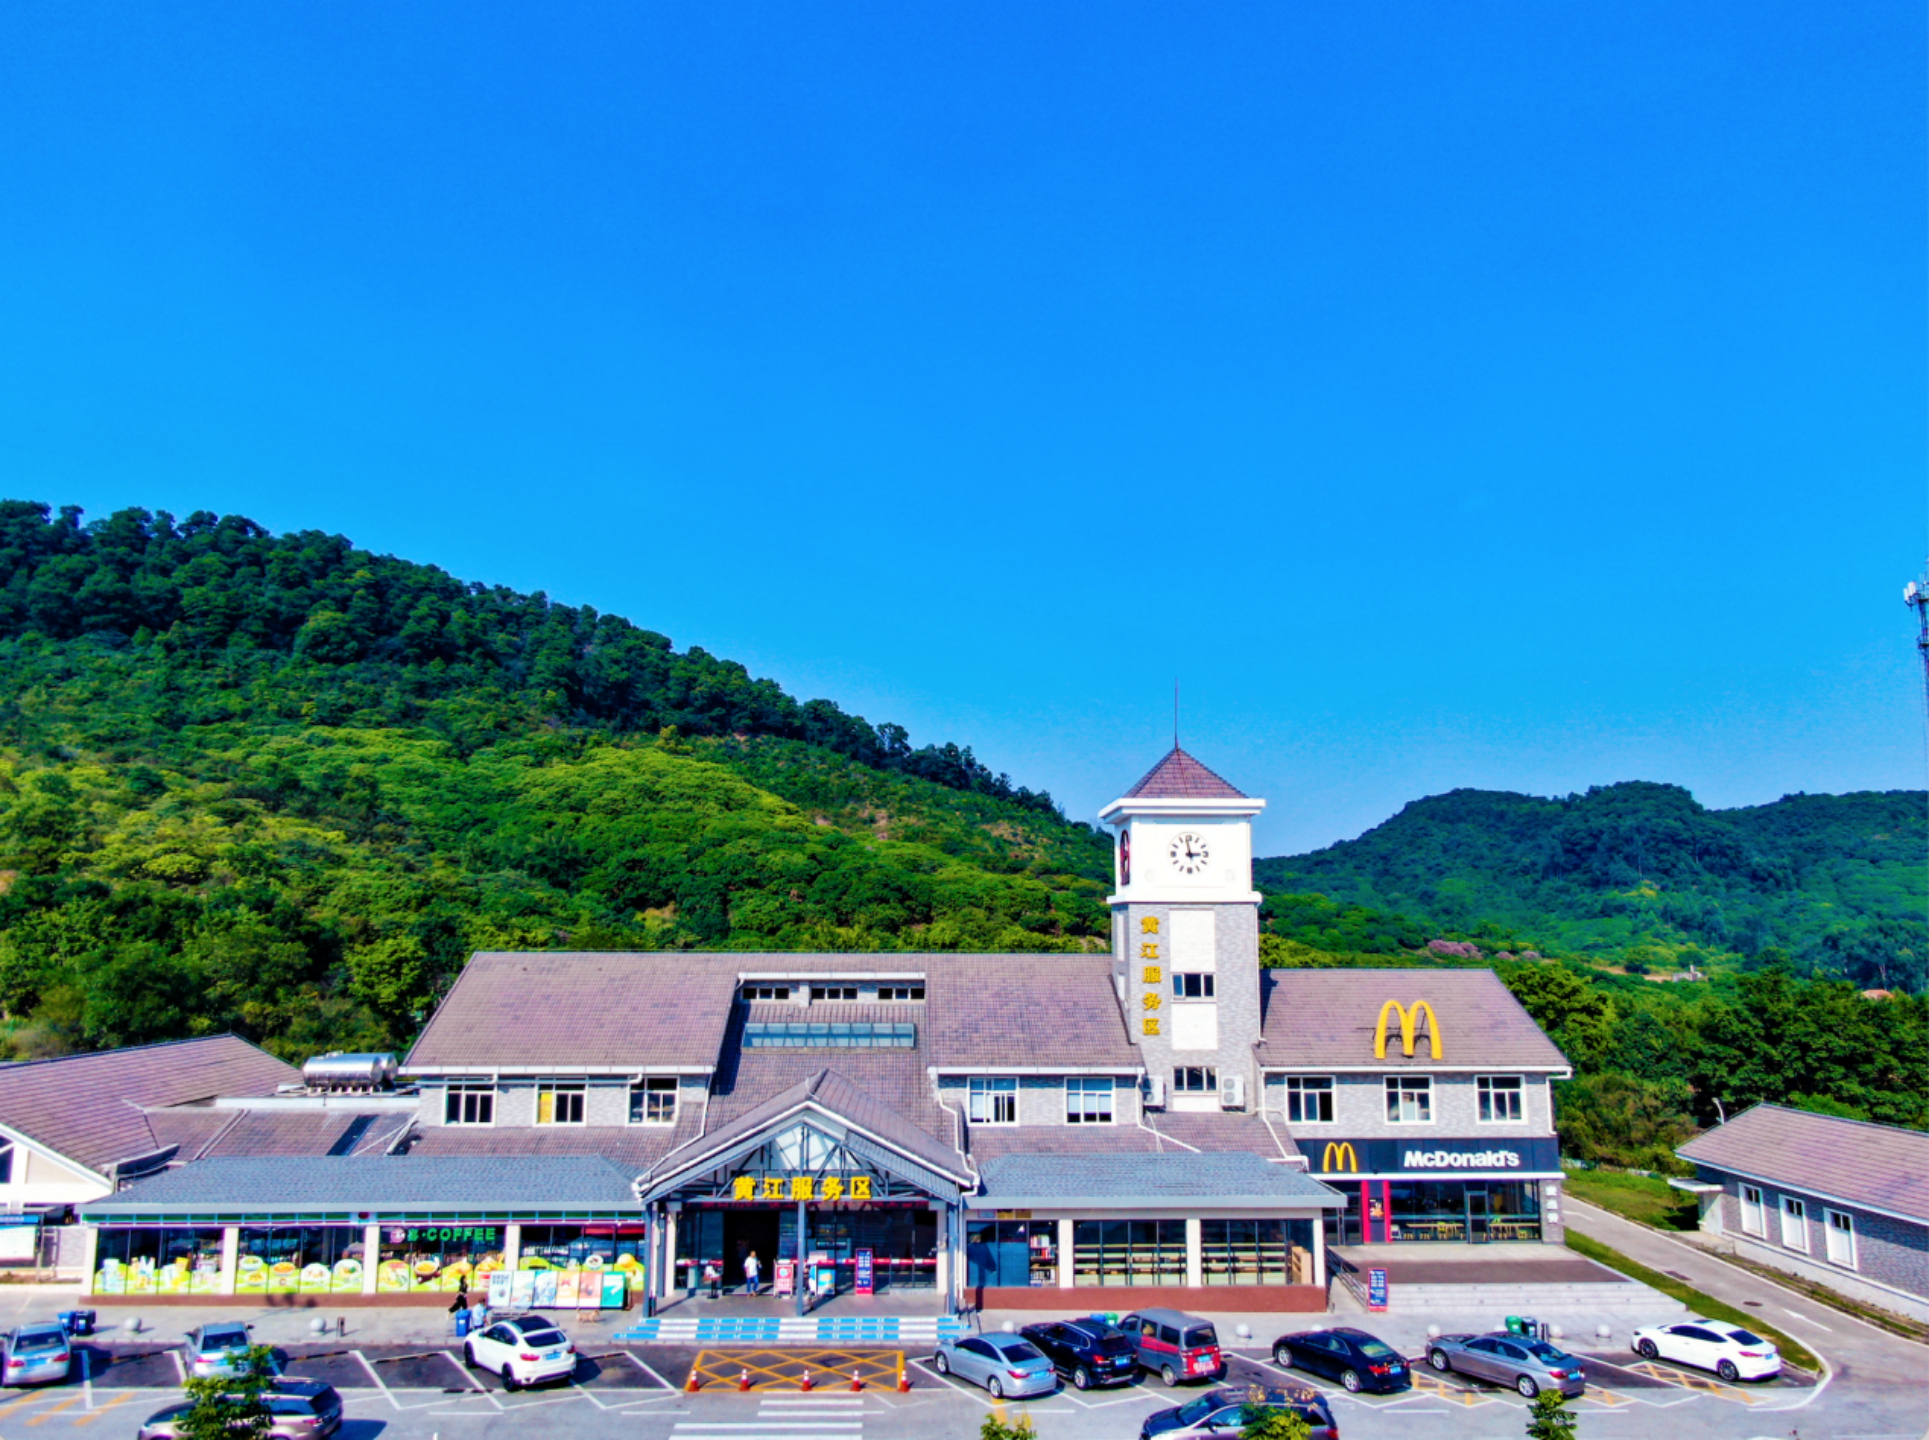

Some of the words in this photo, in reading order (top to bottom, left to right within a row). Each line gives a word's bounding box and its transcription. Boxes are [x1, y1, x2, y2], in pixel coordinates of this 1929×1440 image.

[1140, 916, 1162, 1036] 黄江服务区
[1403, 1150, 1520, 1168] McDonald's
[732, 1176, 872, 1201] 黄江服务区
